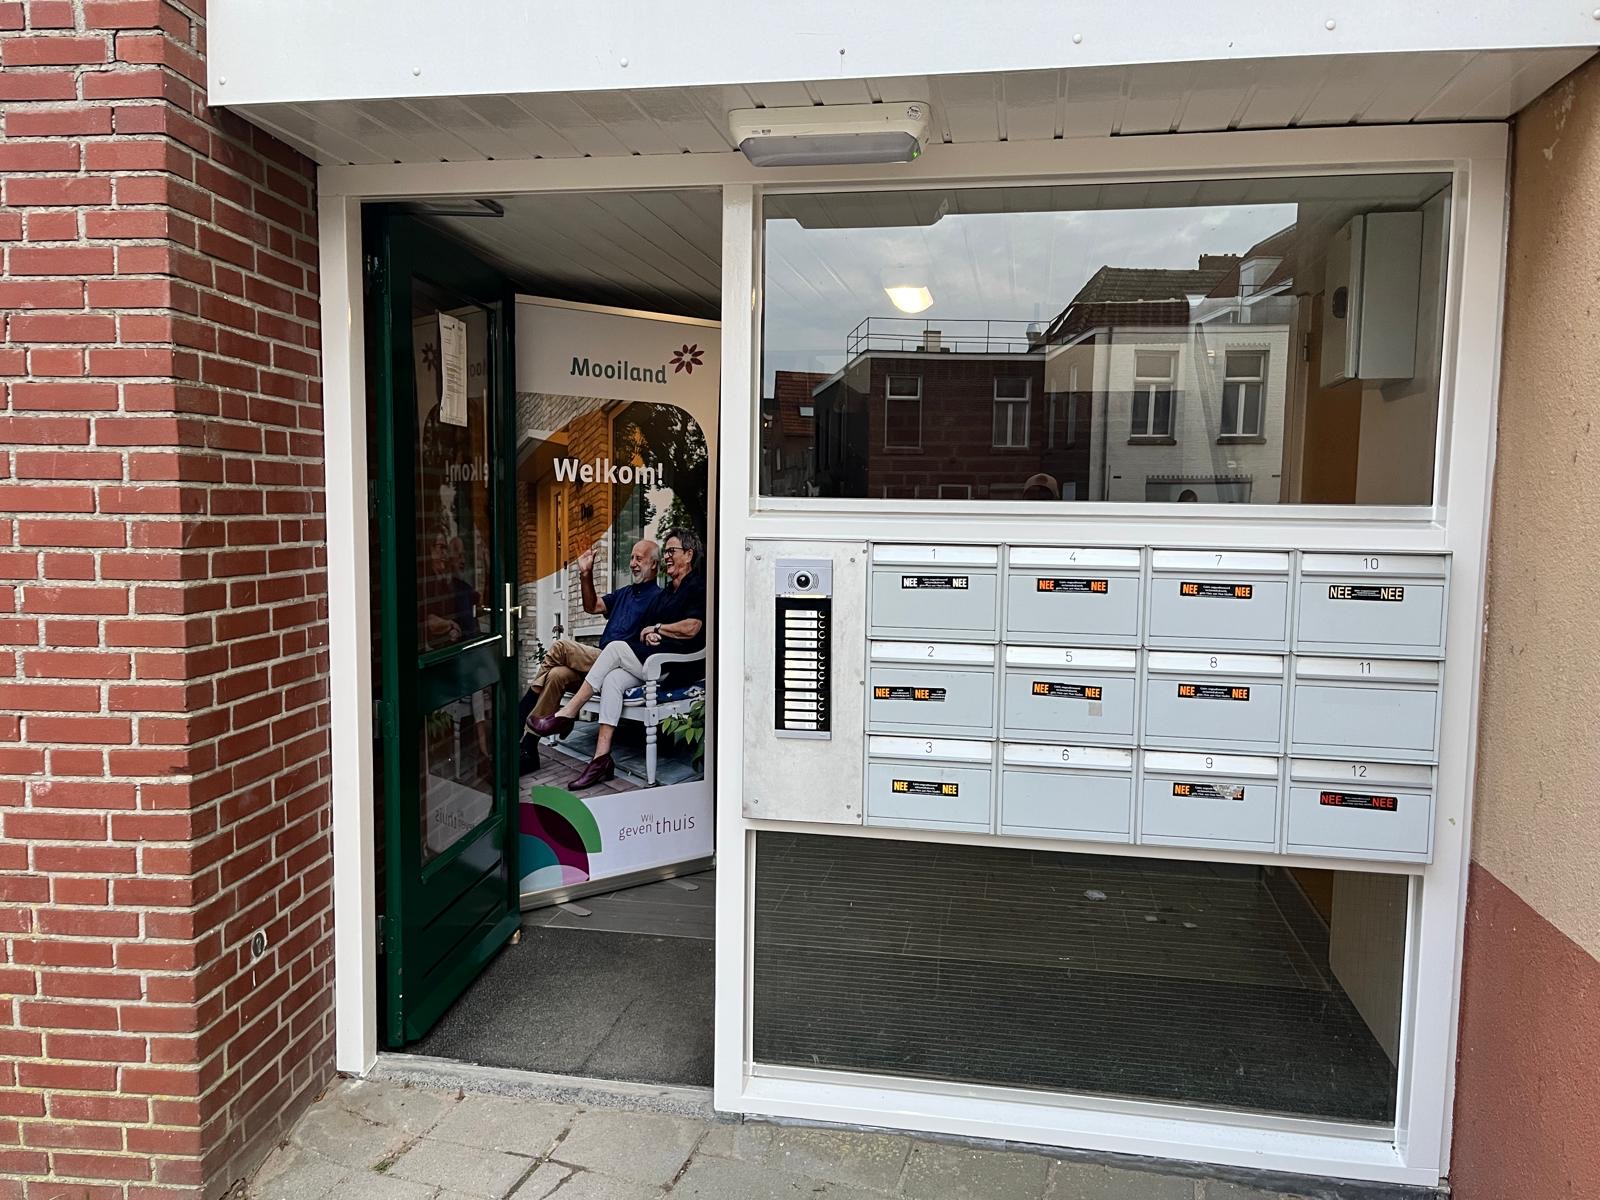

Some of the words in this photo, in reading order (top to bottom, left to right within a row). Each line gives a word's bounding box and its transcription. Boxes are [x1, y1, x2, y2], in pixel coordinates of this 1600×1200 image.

[570, 357, 667, 384] Mooiland
[553, 457, 664, 485] Welkom!
[931, 548, 936, 559] 1
[1069, 551, 1077, 563] 4
[1215, 554, 1223, 566] 7
[1362, 557, 1380, 570] 10
[903, 577, 918, 588] NEE
[952, 578, 967, 588] NEE
[1039, 580, 1055, 590] NEE
[1090, 581, 1106, 592] NEE
[1182, 583, 1199, 595] NEE
[1234, 586, 1251, 597] NEE
[1329, 586, 1352, 598] NEE
[1380, 587, 1403, 600] NEE
[927, 646, 935, 658] 2
[1065, 651, 1073, 662] 5
[1209, 656, 1218, 668] 8
[1359, 661, 1372, 674] 11
[875, 687, 890, 697] NEE
[914, 689, 930, 699] NEE
[1033, 683, 1049, 693] NEE
[1085, 687, 1101, 698] NEE
[1179, 685, 1196, 696] NEE
[1232, 688, 1248, 699] NEE
[925, 741, 933, 754] 3
[1062, 749, 1070, 761] 6
[1205, 757, 1213, 769] 9
[1351, 765, 1368, 778] 12
[893, 781, 908, 791] NEE
[942, 784, 957, 795] NEE
[1174, 784, 1190, 795] NEE
[1321, 793, 1343, 804] NEE
[1372, 797, 1394, 808] NEE
[641, 813, 654, 824] Wij
[619, 822, 652, 841] geven
[656, 814, 695, 835] thuis
